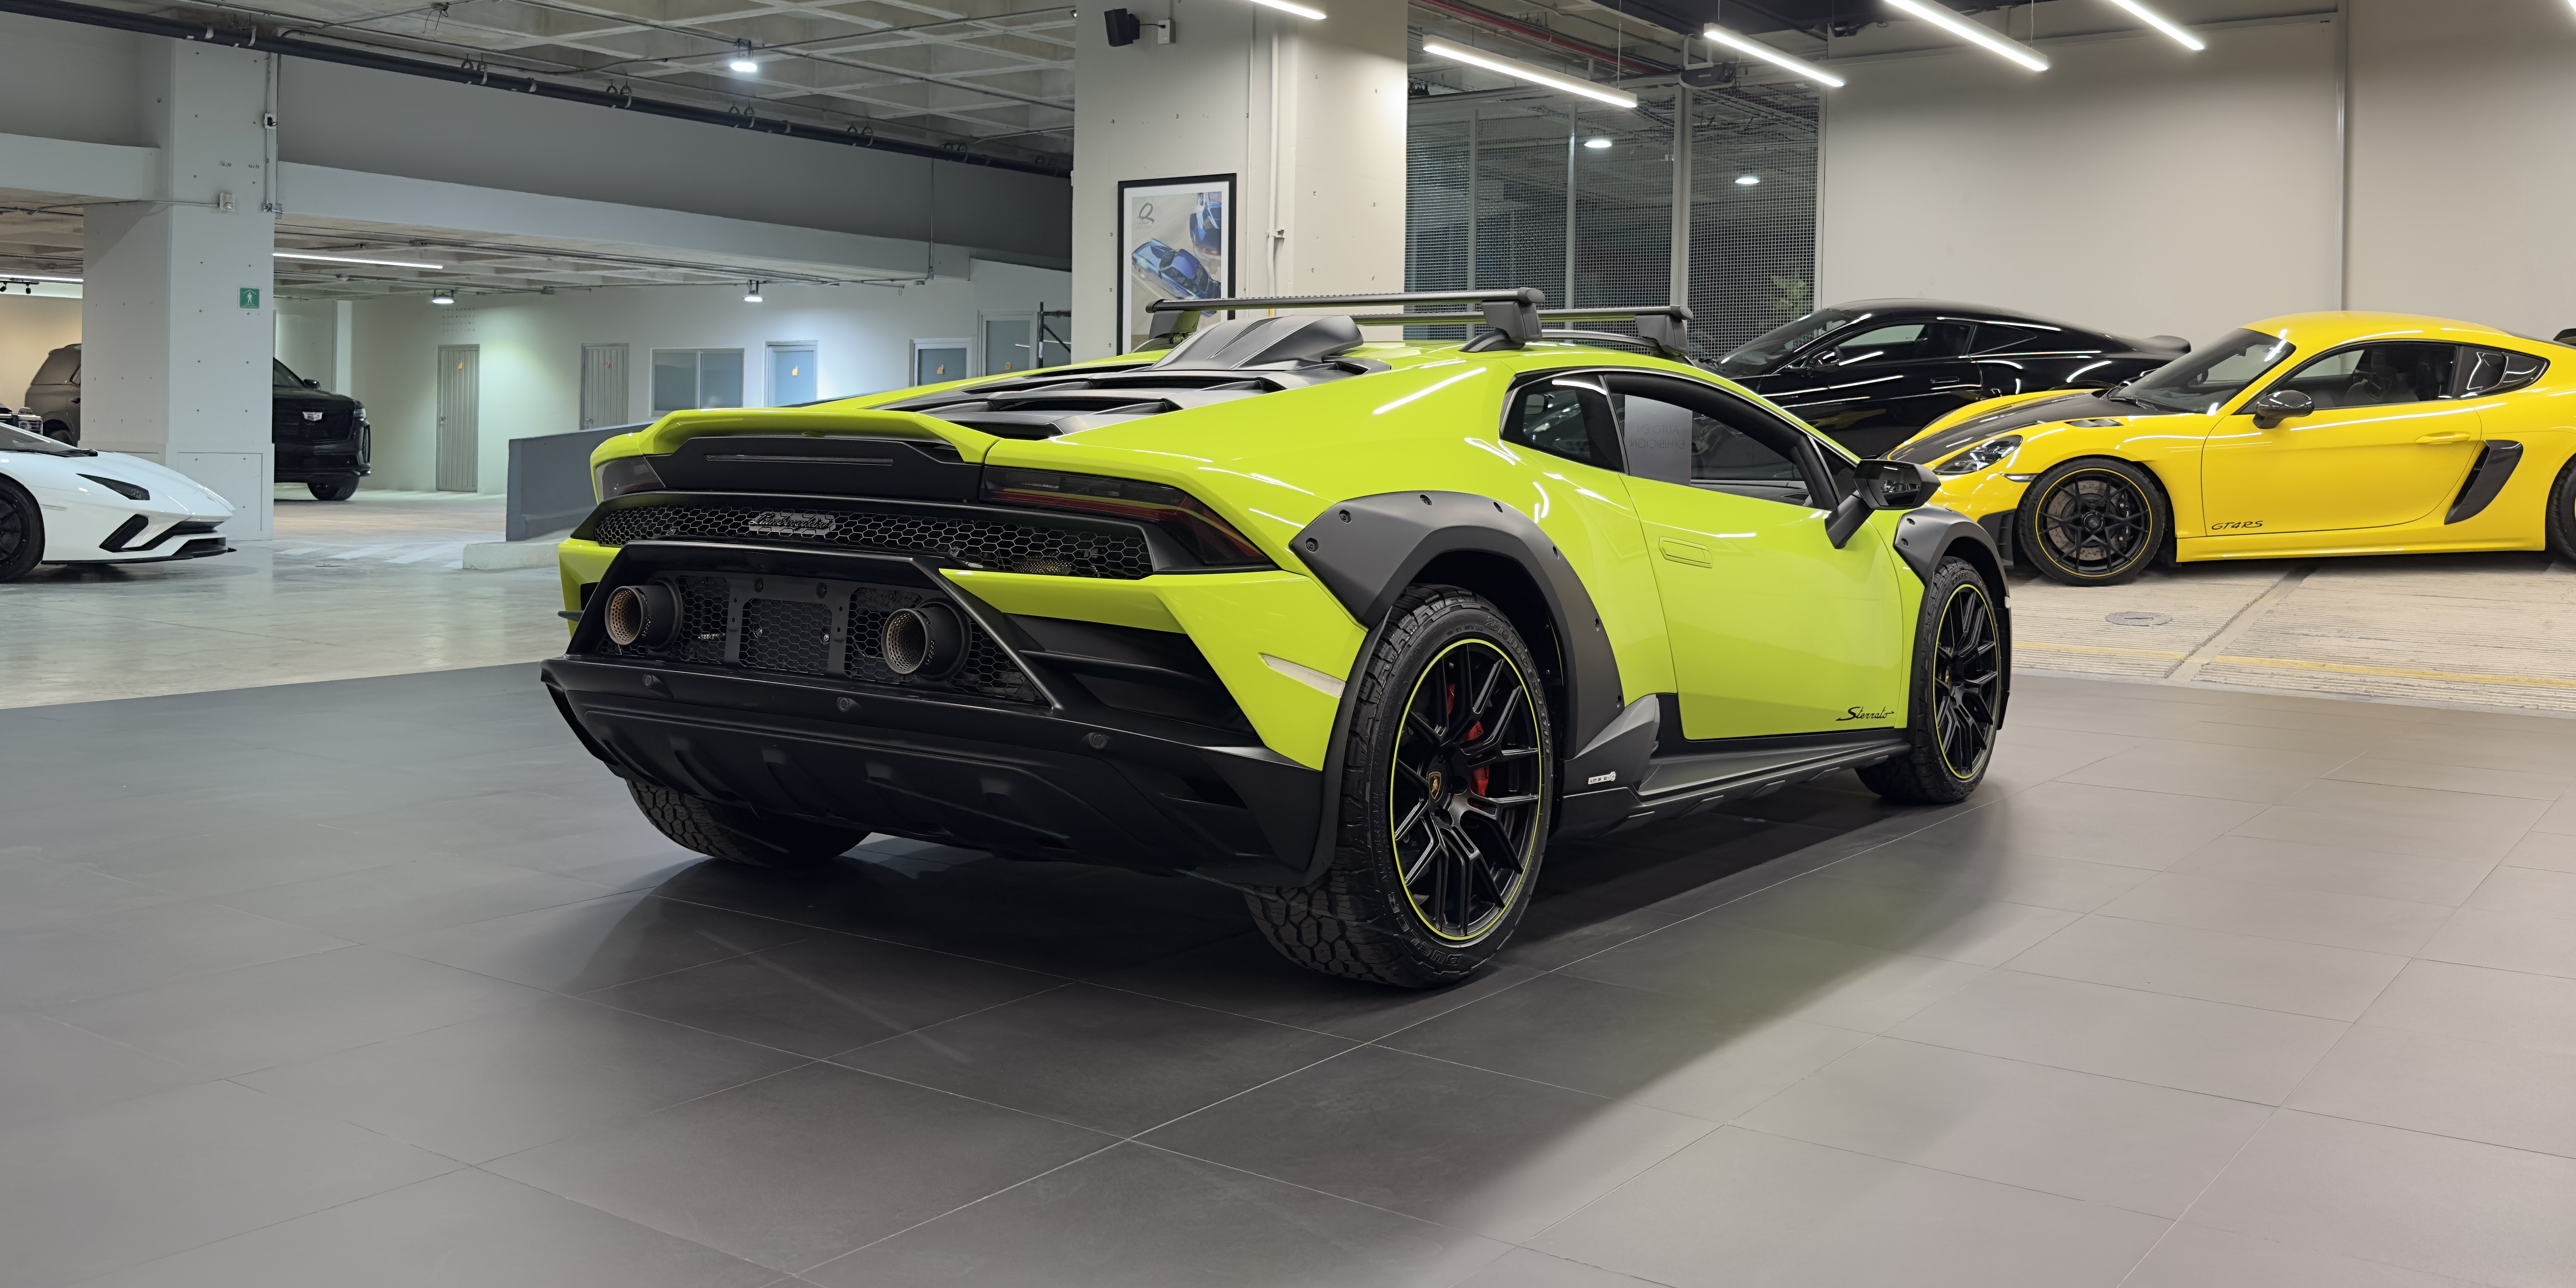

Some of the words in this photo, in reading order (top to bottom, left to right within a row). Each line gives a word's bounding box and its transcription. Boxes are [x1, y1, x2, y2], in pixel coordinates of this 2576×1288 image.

[1137, 202, 1154, 224] Q
[749, 512, 833, 530] Lamborghini
[1836, 706, 1894, 721] Sterrato
[1388, 892, 1463, 966] DUELER
